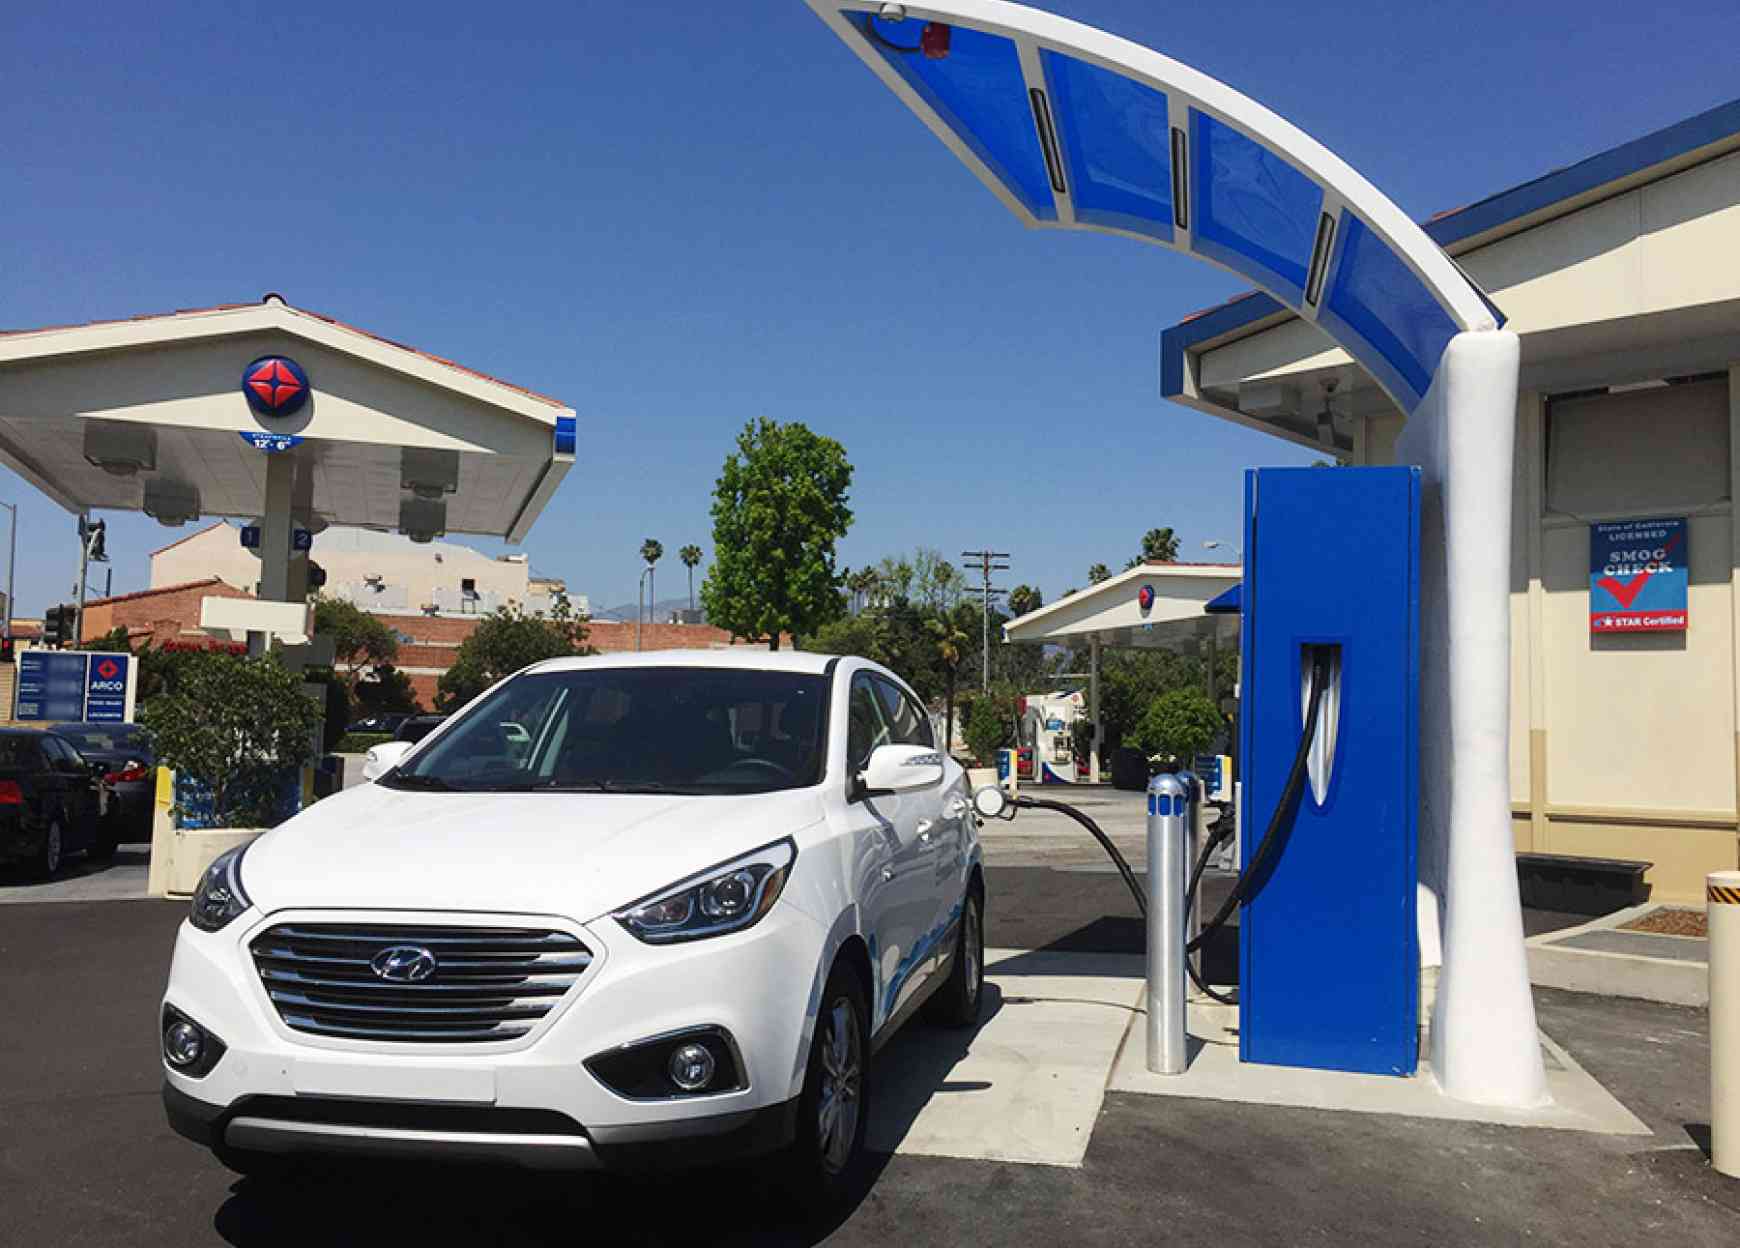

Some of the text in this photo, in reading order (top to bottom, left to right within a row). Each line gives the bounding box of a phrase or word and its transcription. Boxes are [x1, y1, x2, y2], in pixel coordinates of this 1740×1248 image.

[1609, 530, 1667, 541] LICENSED
[1609, 548, 1666, 562] SMOG
[1603, 561, 1673, 576] CHECK
[1615, 615, 1685, 626] STAR Certified
[90, 680, 123, 691] ARCO
